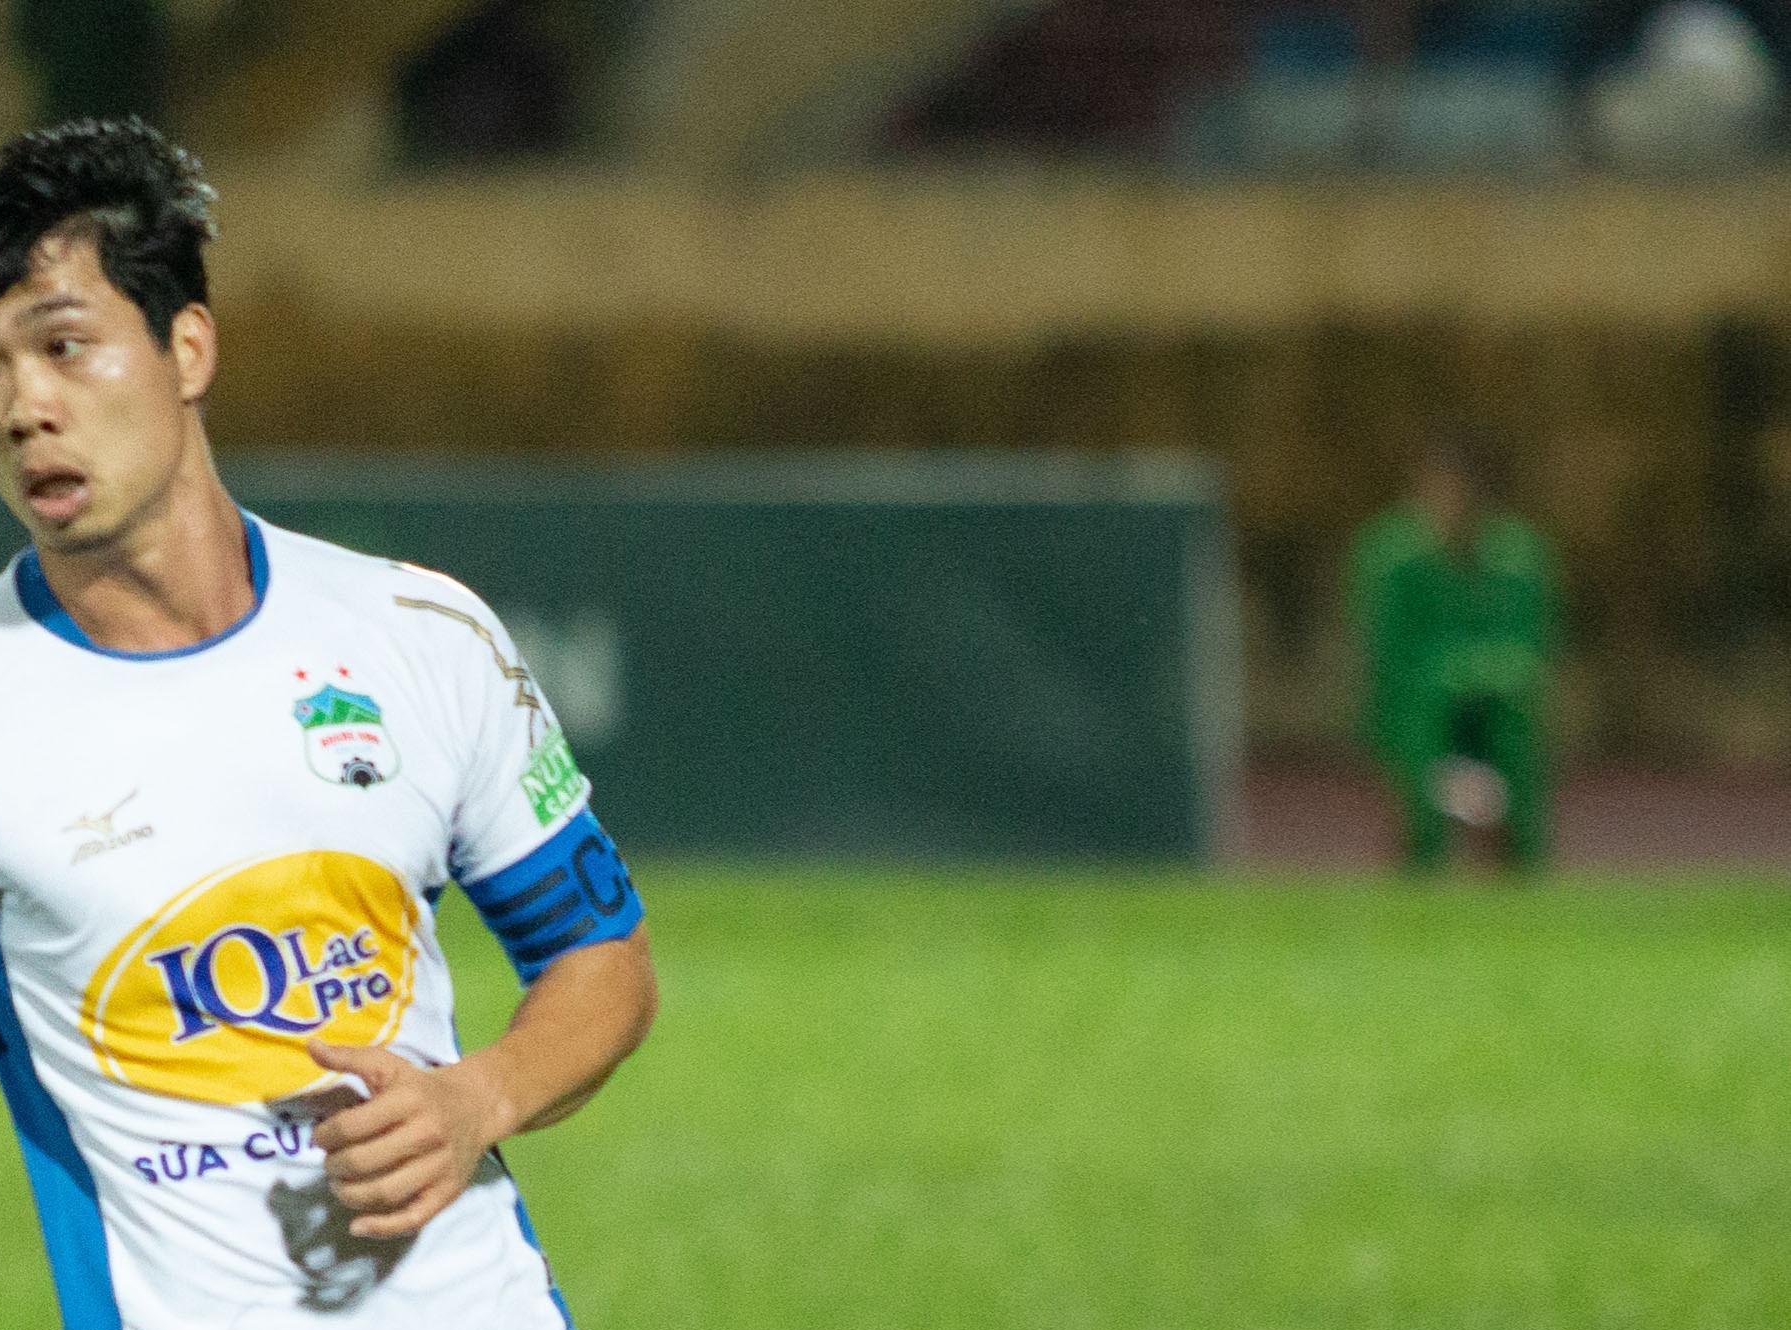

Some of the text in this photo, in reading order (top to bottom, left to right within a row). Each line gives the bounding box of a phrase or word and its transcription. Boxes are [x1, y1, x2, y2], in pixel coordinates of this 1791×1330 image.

[148, 926, 378, 1043] IQ Lac
[314, 973, 392, 1022] Pro
